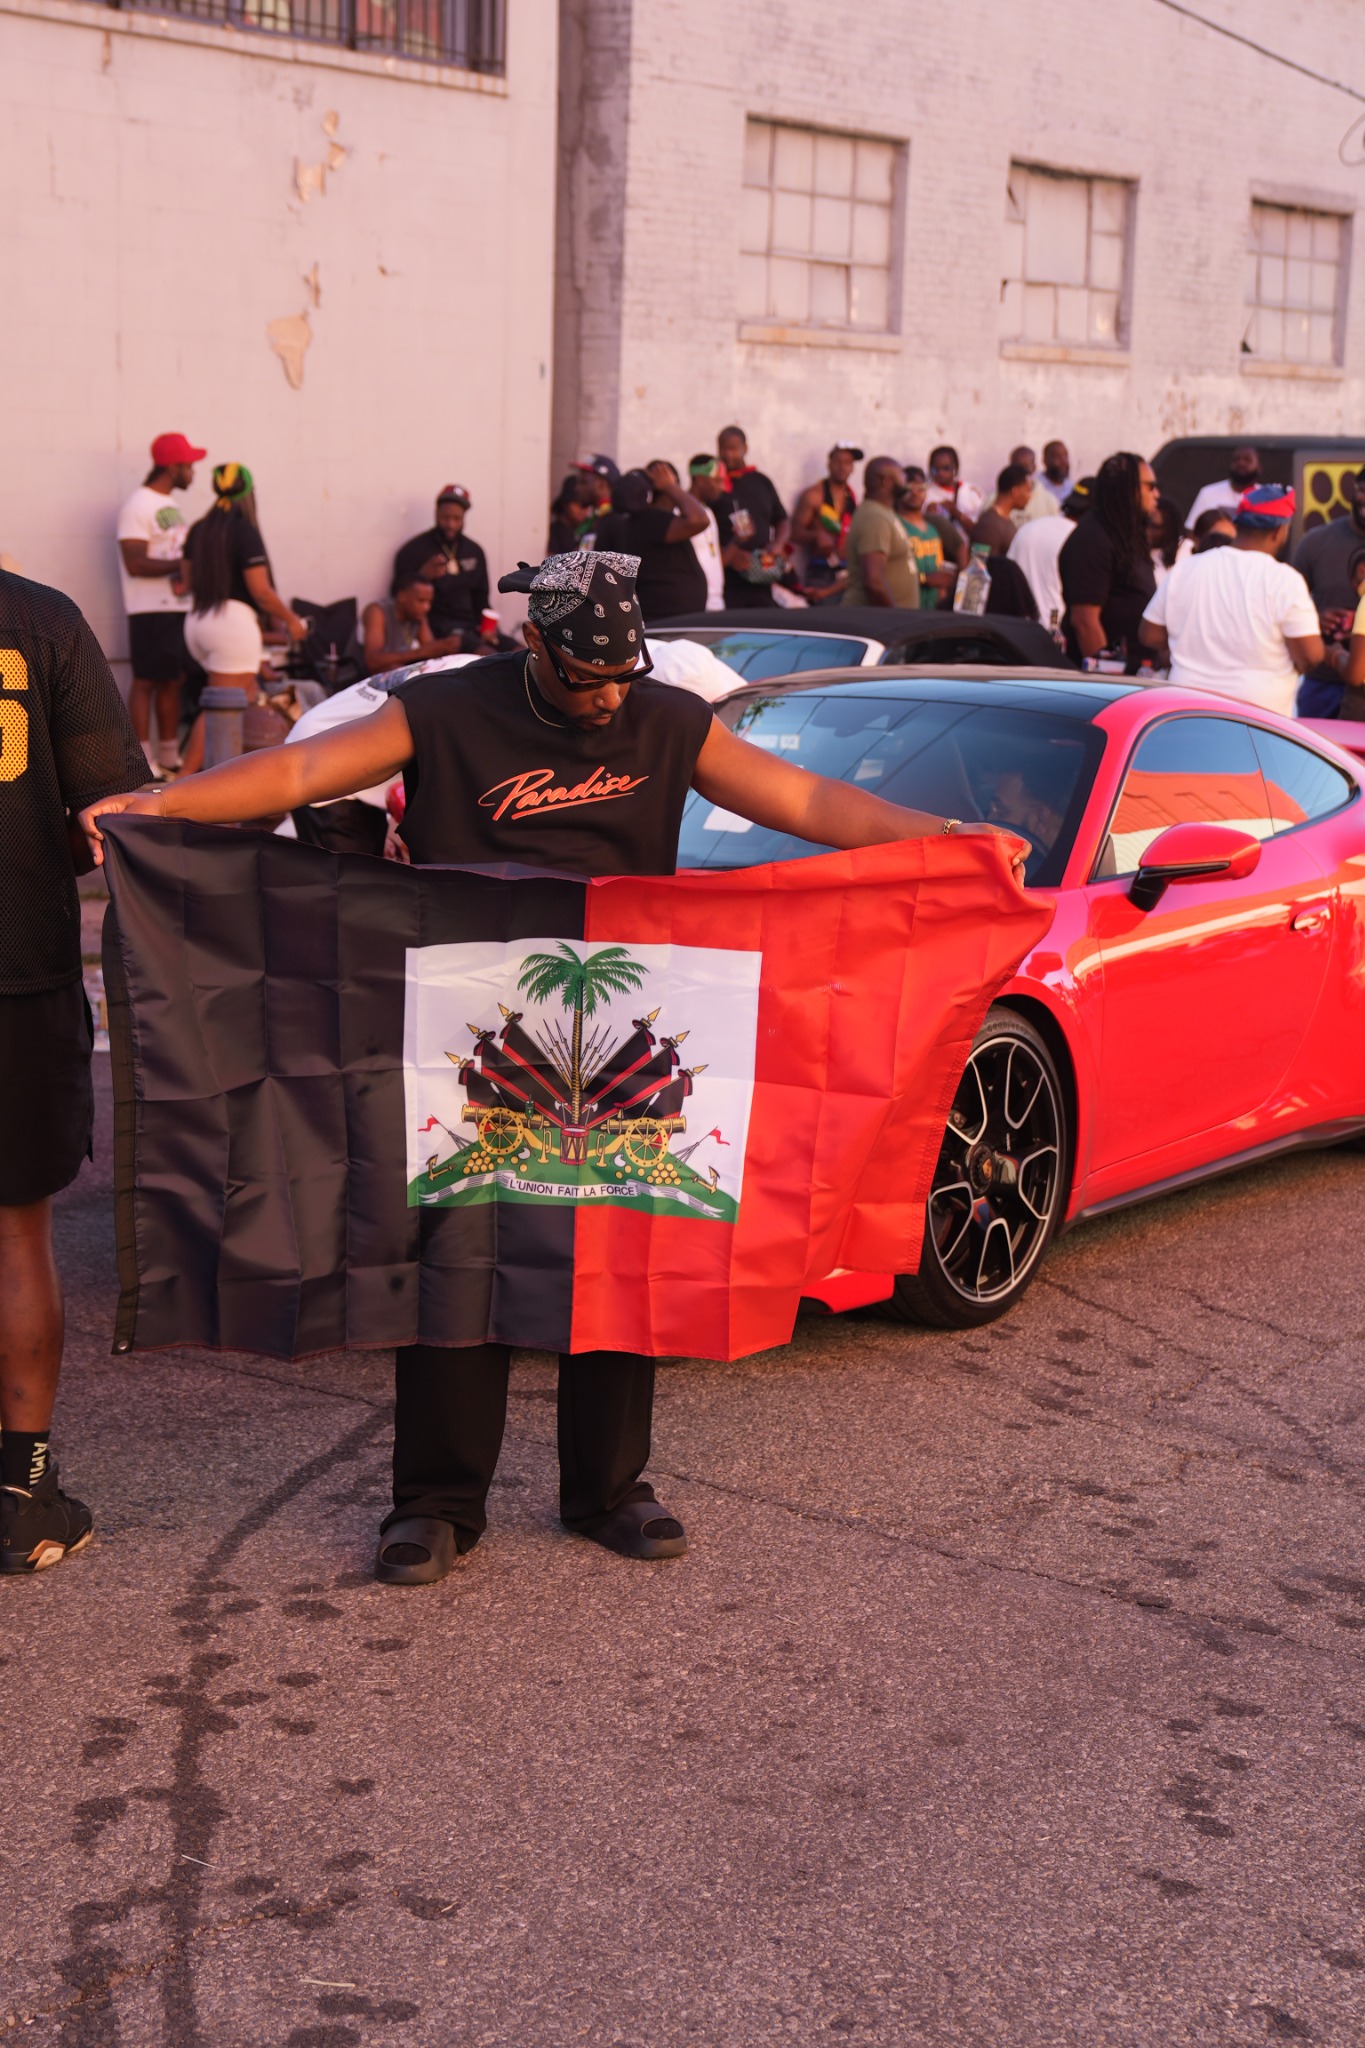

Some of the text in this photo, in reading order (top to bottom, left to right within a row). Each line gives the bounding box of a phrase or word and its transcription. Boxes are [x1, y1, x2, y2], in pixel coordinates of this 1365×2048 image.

[478, 766, 649, 821] Paradise
[509, 1180, 635, 1197] L'UNION FAIT LA FORCE
